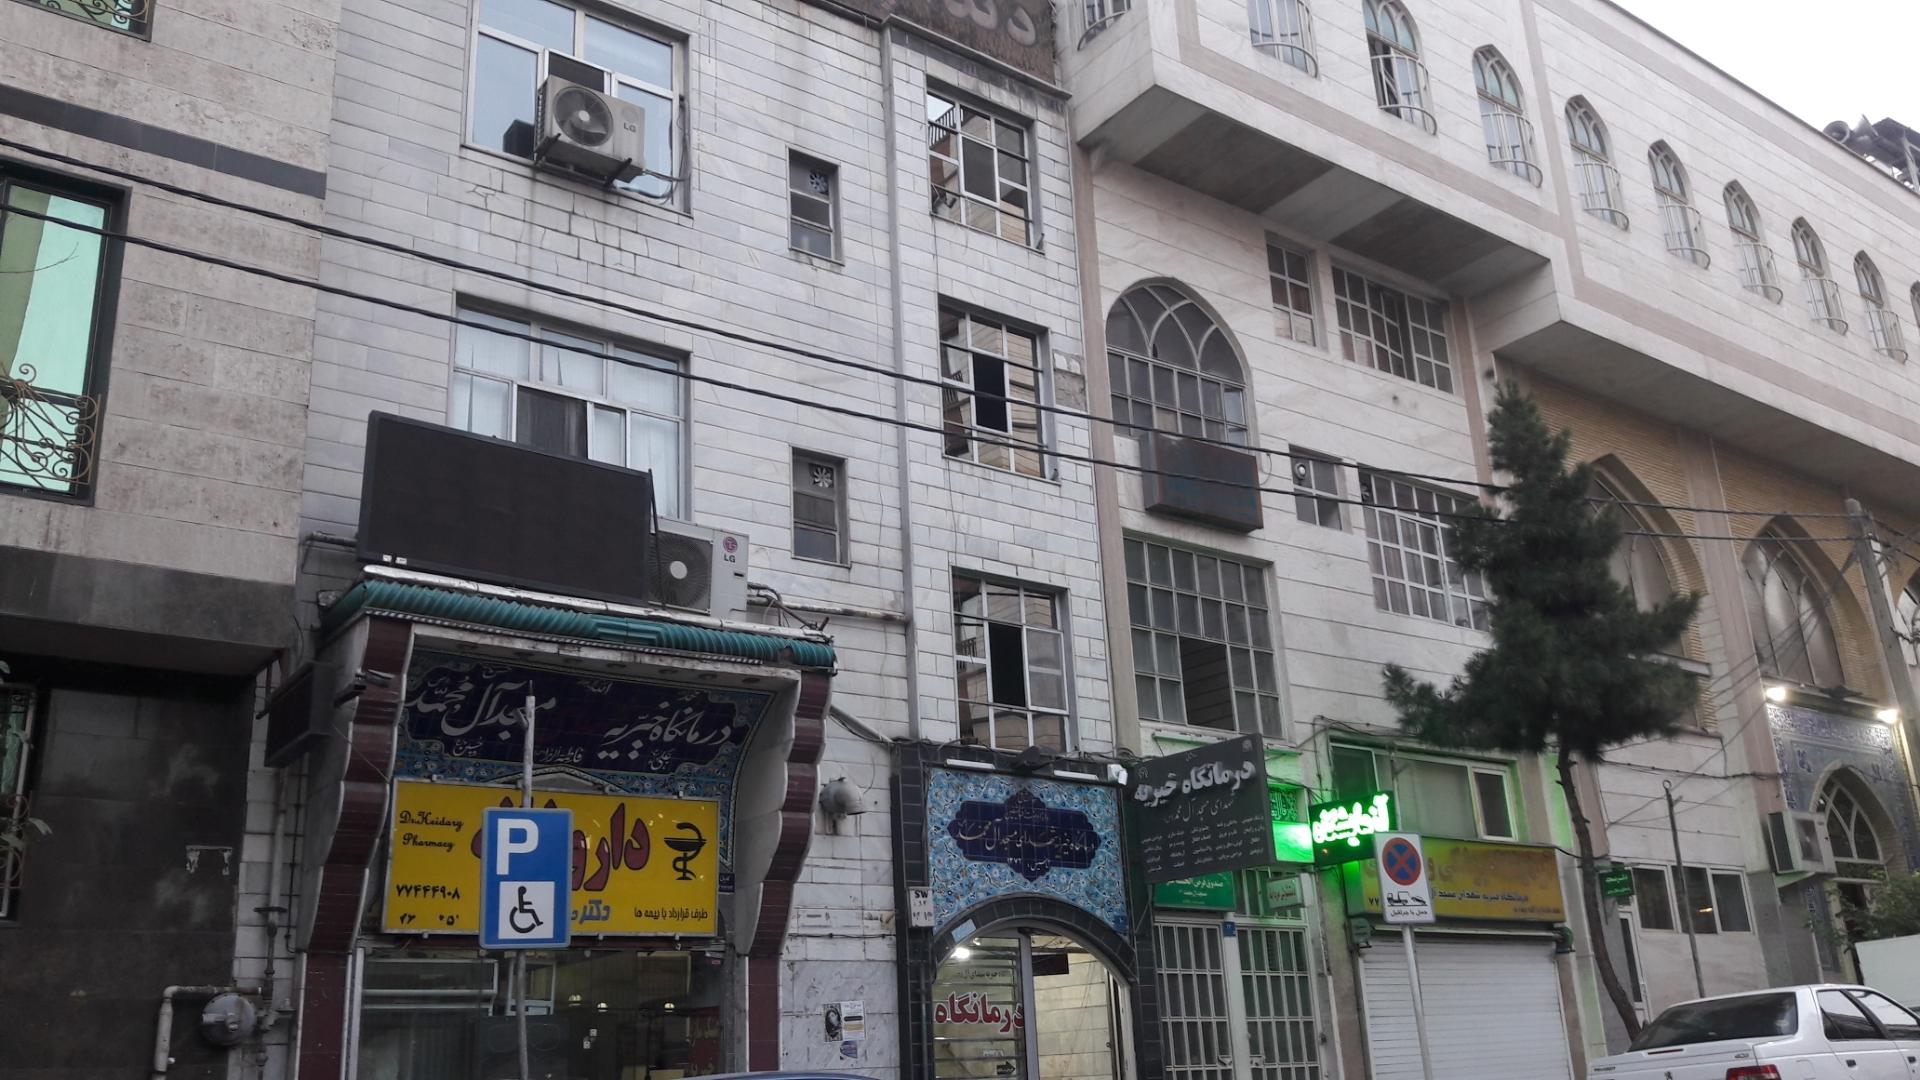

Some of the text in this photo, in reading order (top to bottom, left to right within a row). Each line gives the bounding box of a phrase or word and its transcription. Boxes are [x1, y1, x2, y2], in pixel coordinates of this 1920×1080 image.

[623, 123, 637, 133] LG
[723, 553, 736, 563] LG
[649, 705, 732, 745] درمانگاه
[1134, 761, 1257, 807] درمانگاه خیریه
[402, 832, 455, 852] Pharmacy
[496, 818, 539, 875] P
[914, 889, 928, 899] SW
[580, 900, 610, 924] دکتر
[668, 907, 689, 922] قرارداد
[691, 908, 708, 921] طرف
[1416, 909, 1428, 917] حمل
[935, 993, 1024, 1033] درمانگاه
